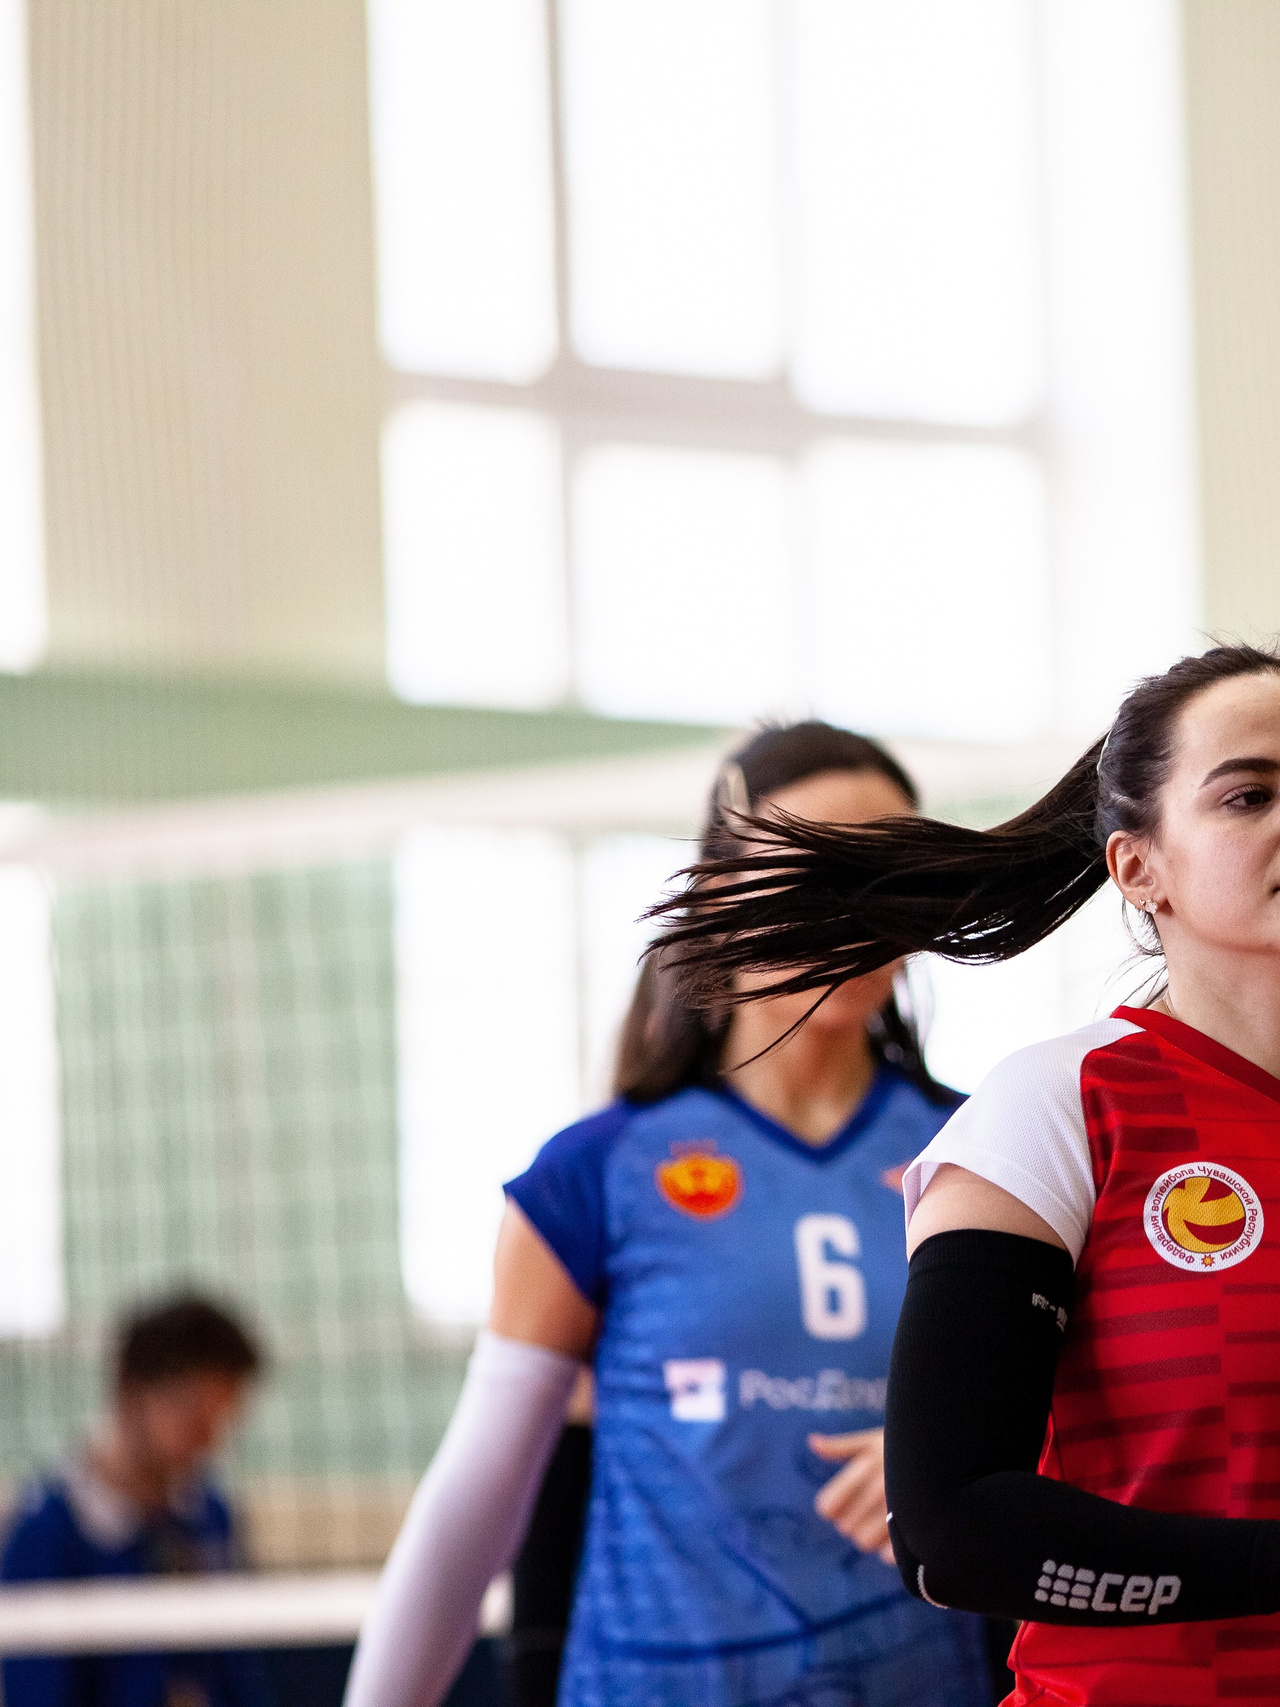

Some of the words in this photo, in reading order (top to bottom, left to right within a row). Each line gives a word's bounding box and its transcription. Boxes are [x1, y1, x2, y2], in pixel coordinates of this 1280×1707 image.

[1152, 1168, 1195, 1212] волейбола
[1198, 1166, 1254, 1206] Чувашской
[1151, 1216, 1195, 1264] Федерация
[1220, 1208, 1258, 1260] Республики
[794, 1213, 867, 1341] 6
